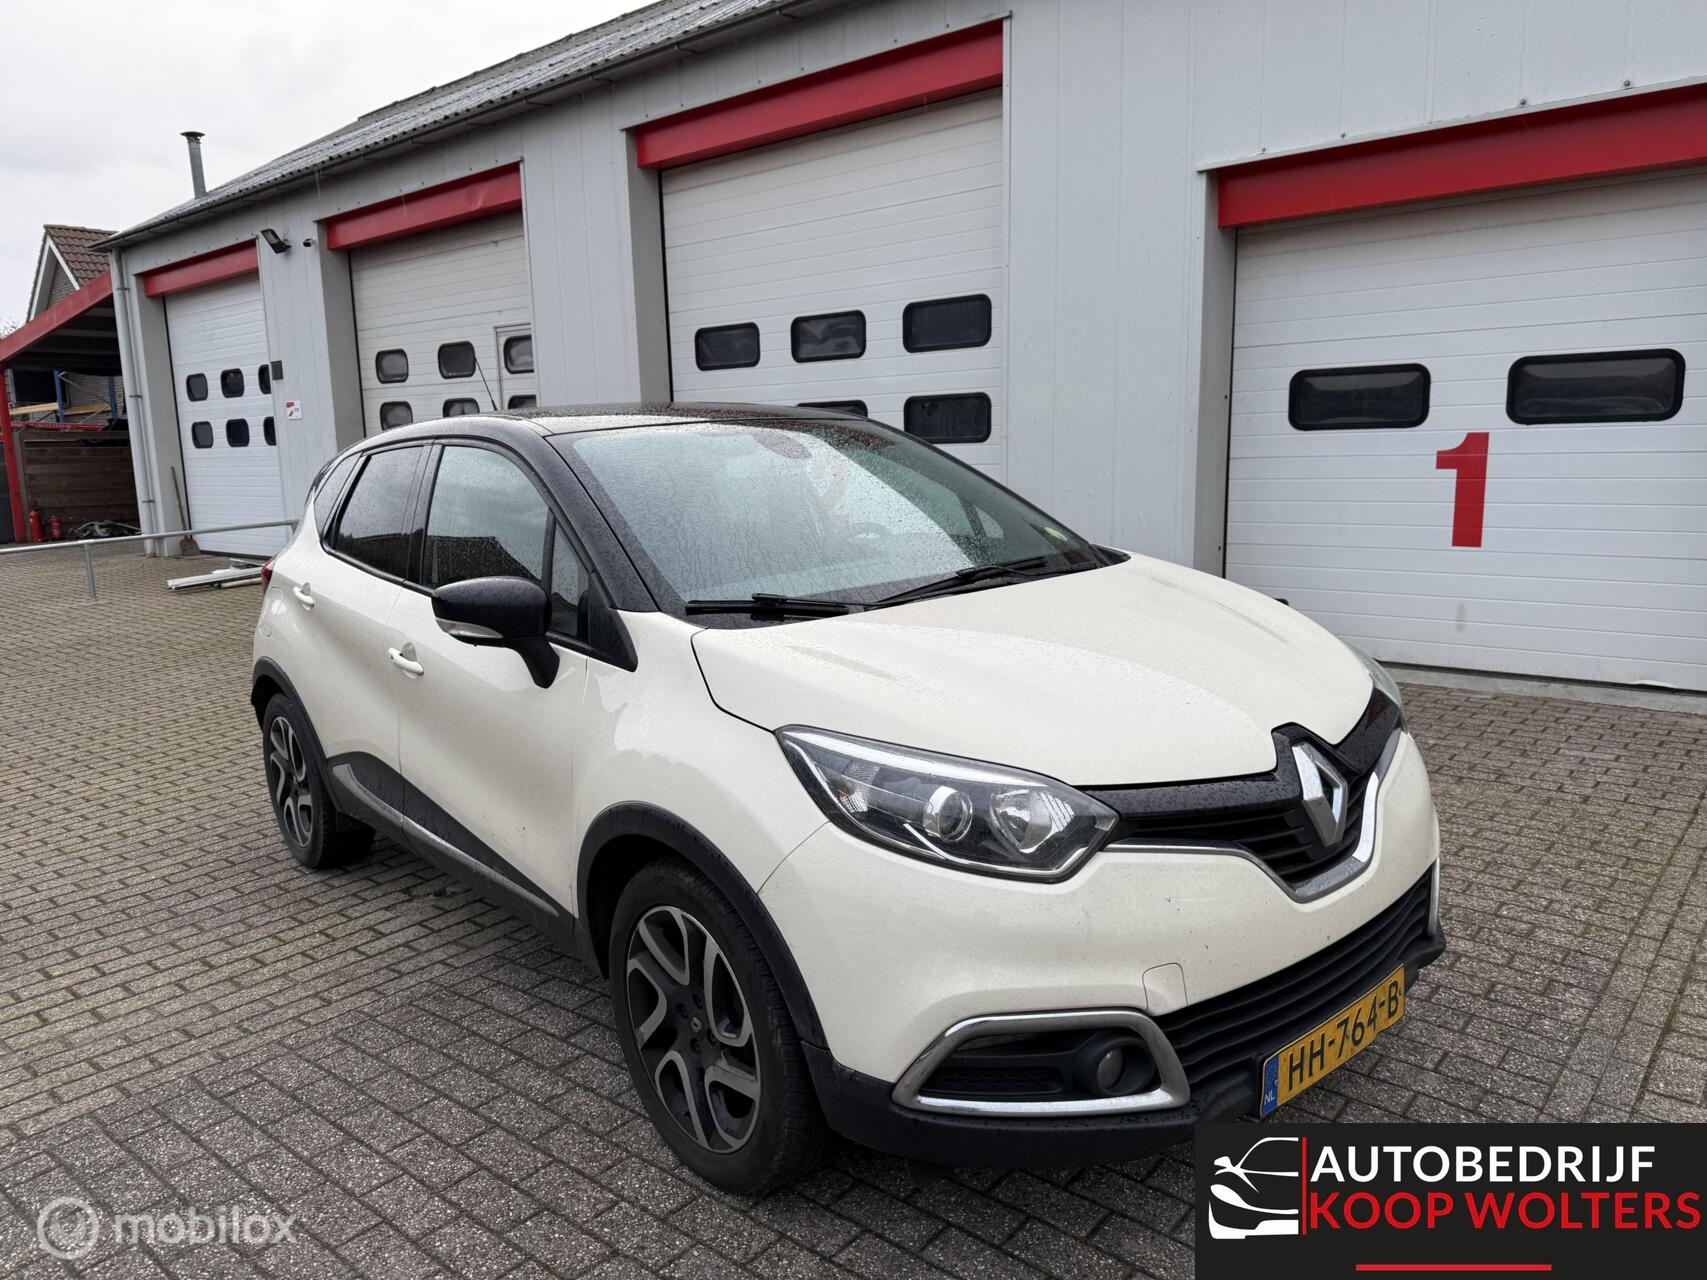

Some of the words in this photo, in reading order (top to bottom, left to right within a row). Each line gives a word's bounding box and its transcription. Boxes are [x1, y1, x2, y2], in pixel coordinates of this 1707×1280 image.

[1436, 432, 1490, 548] 1
[1287, 980, 1400, 1092] HH-764-B
[1264, 1090, 1276, 1105] NL
